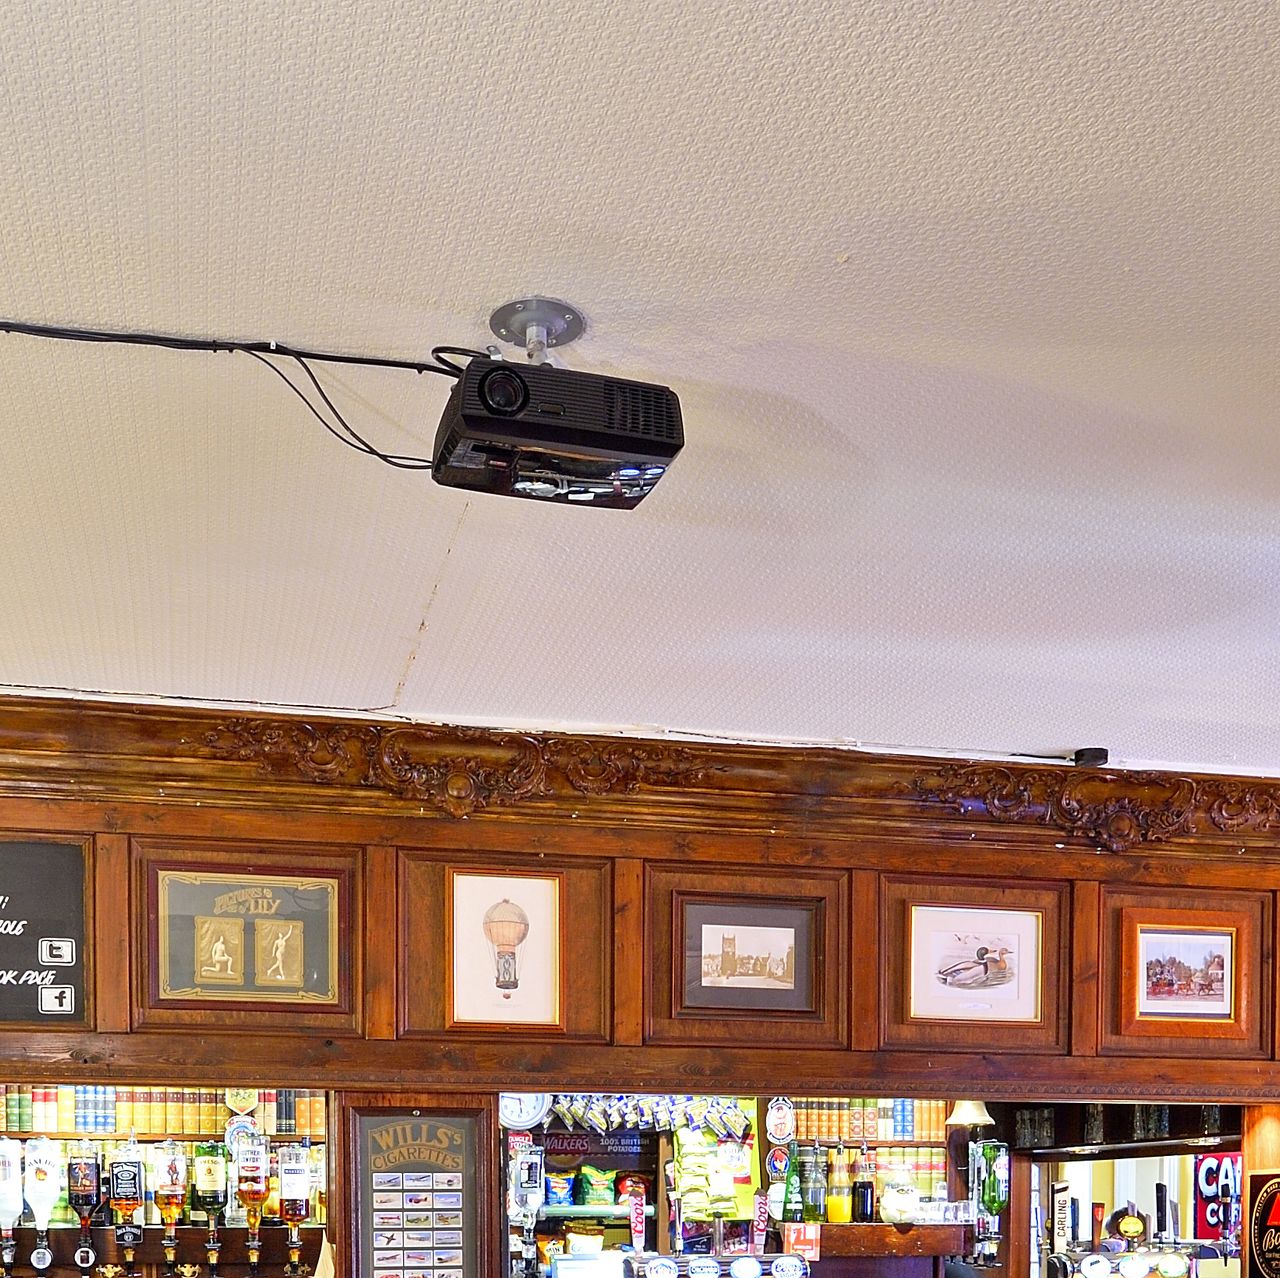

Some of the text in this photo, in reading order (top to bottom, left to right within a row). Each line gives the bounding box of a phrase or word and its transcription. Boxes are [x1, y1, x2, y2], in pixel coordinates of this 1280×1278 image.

[18, 970, 57, 985] PAGE
[544, 1136, 589, 1150] WALKERS
[372, 1147, 460, 1169] CIGARETTES
[1057, 1199, 1067, 1237] CARLING
